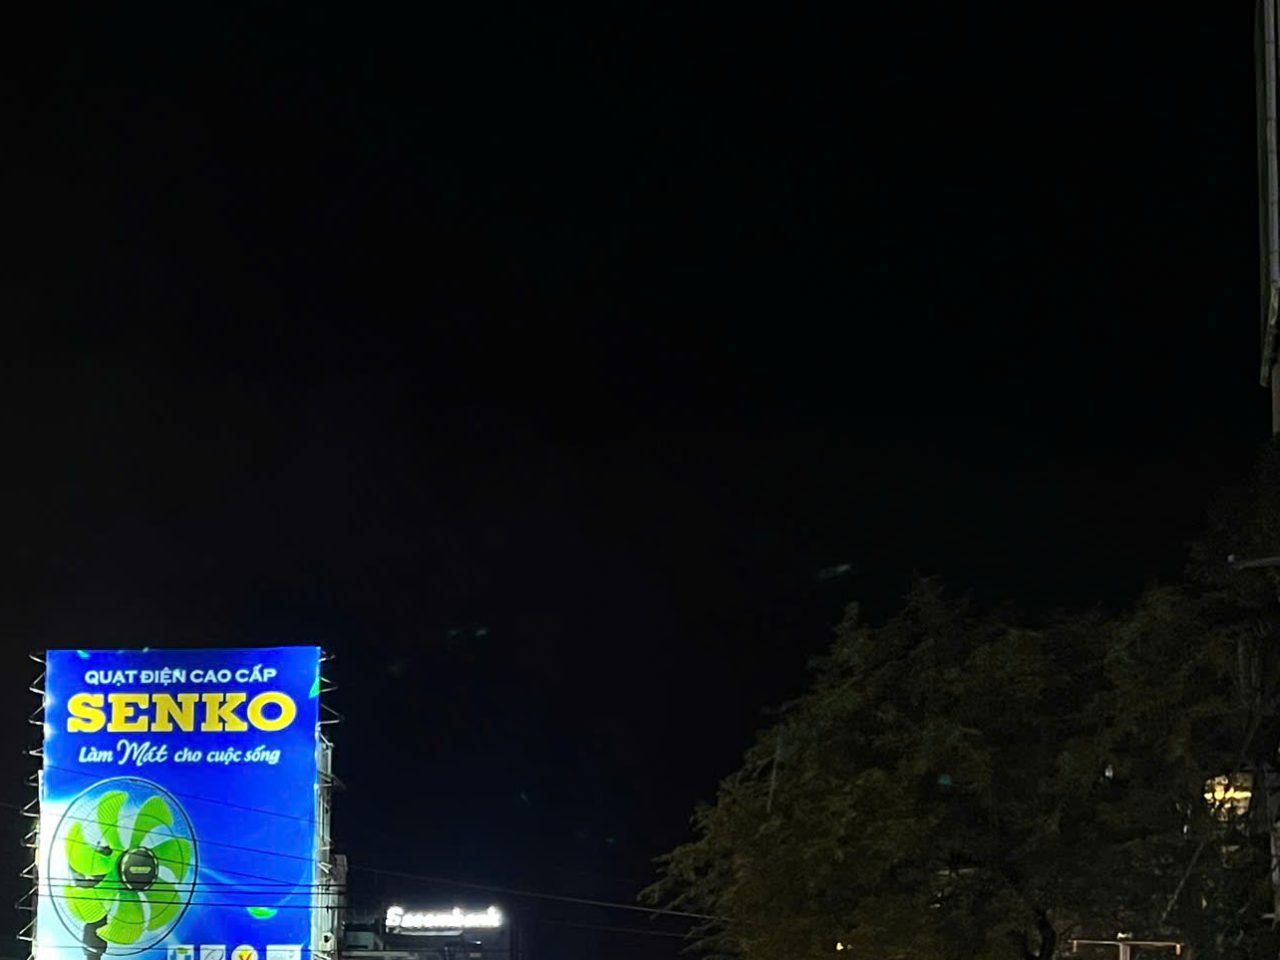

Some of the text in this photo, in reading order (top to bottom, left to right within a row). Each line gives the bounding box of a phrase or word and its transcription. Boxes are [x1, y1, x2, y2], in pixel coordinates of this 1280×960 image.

[84, 664, 278, 686] QUẠT ĐIỆN CAO CẤP
[67, 691, 297, 733] SENKO
[78, 739, 281, 767] Làm Mát cho cuộc sống
